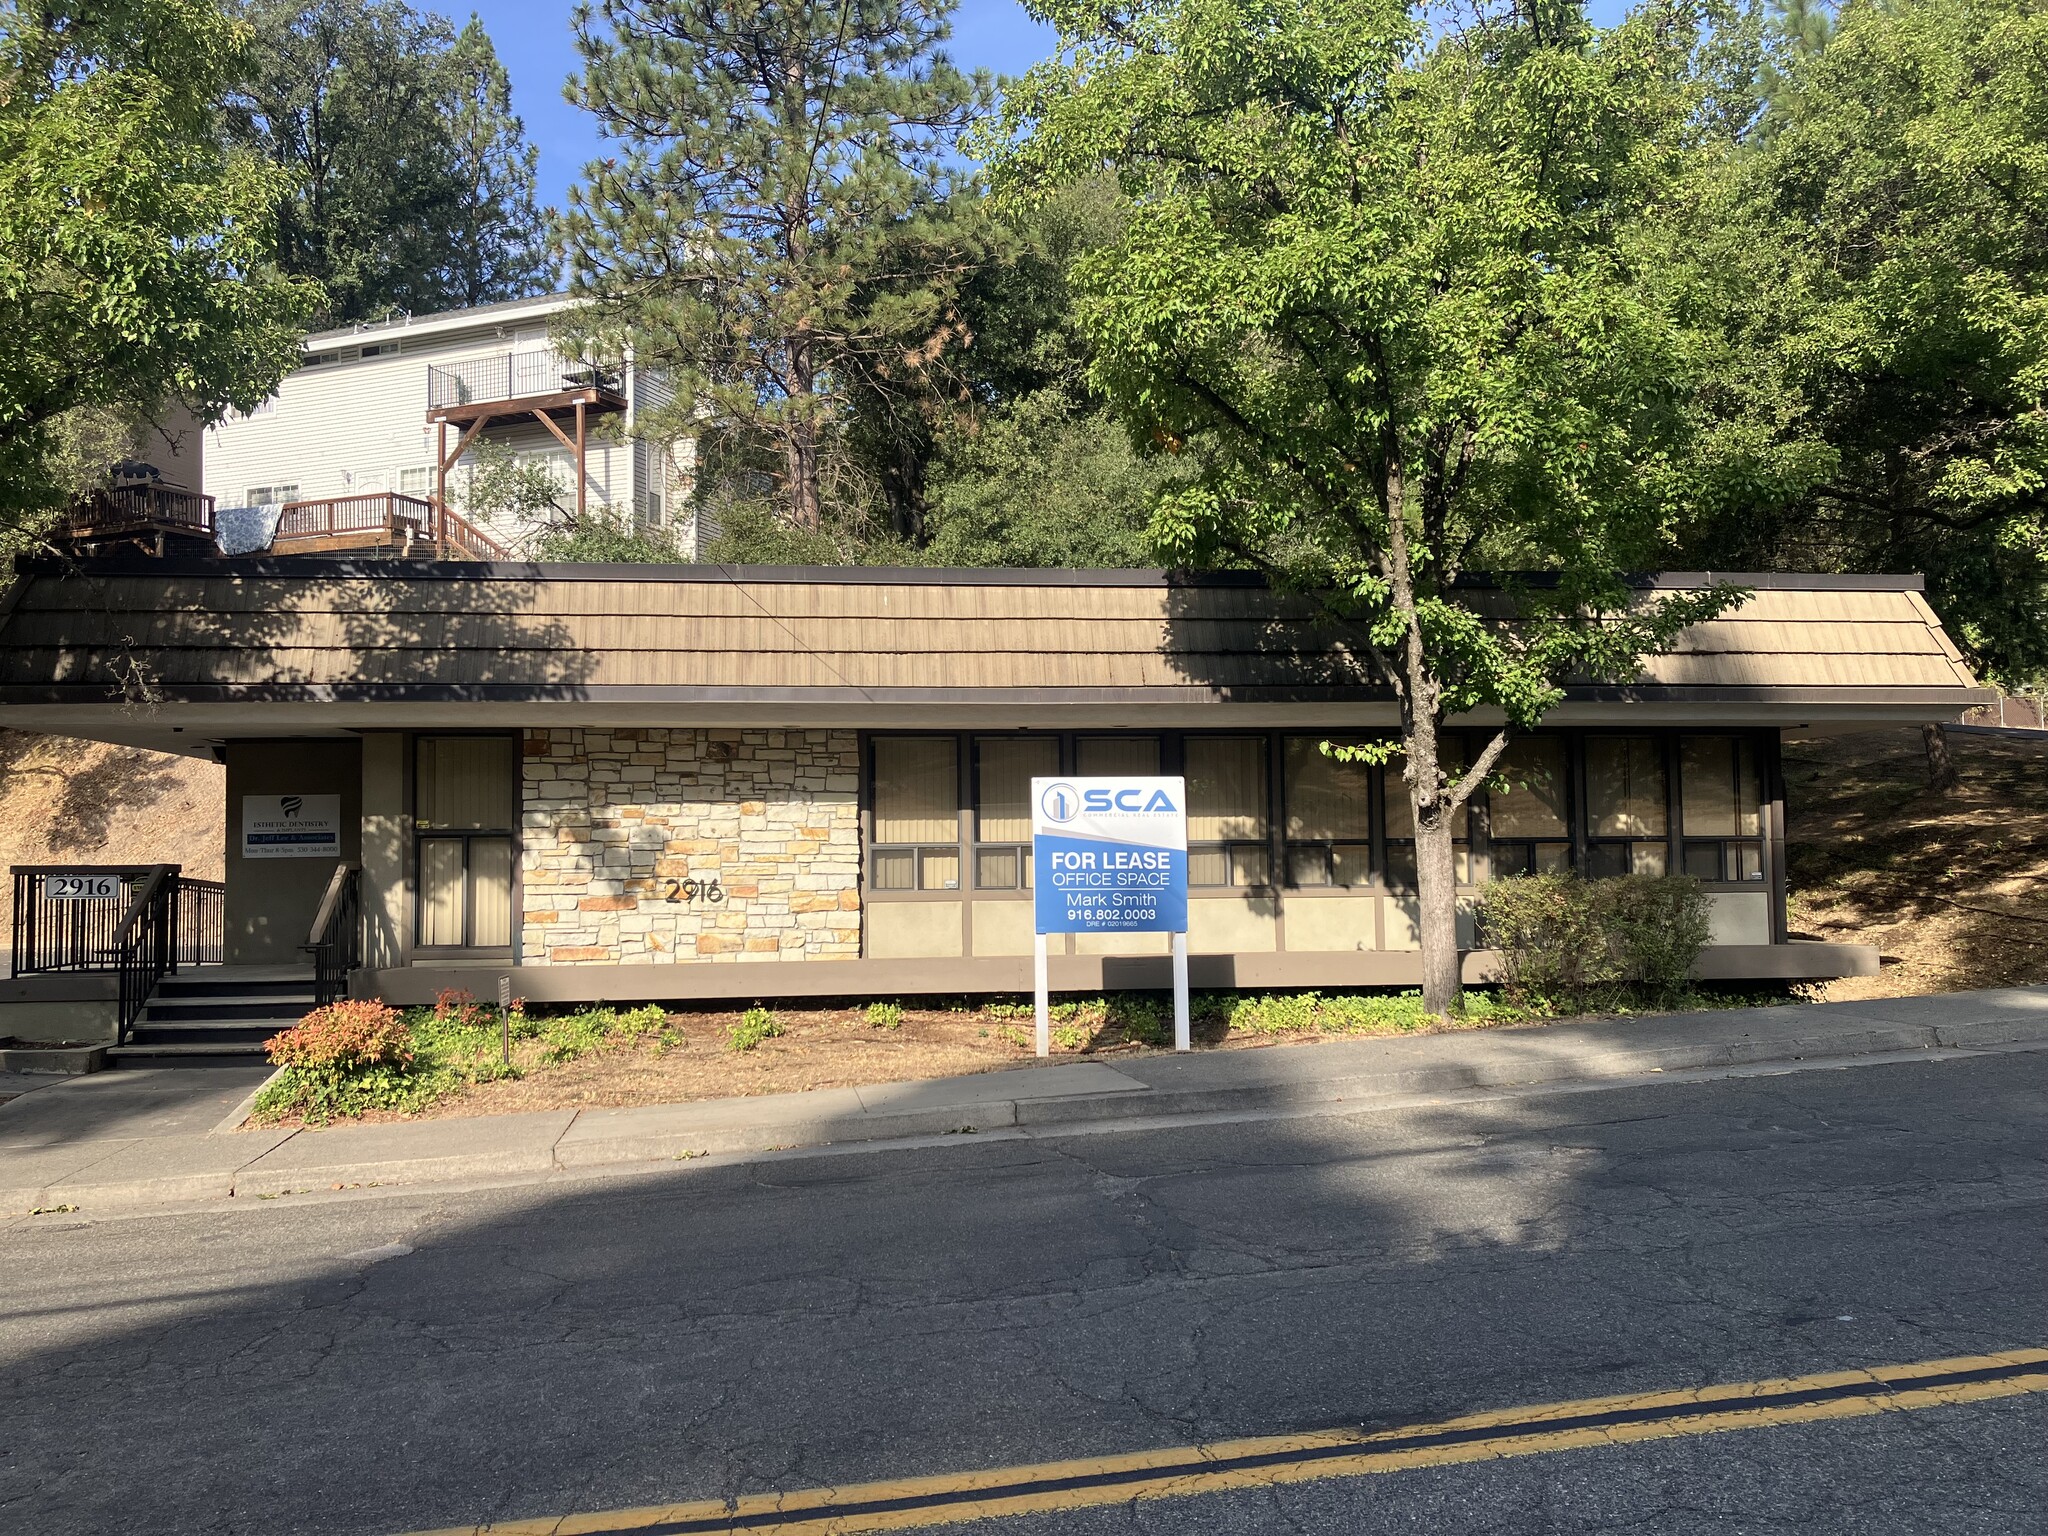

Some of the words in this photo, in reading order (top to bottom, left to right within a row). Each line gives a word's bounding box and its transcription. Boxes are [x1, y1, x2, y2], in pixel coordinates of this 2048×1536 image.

[1084, 789, 1177, 812] SCA
[262, 835, 275, 843] Jeff
[1052, 852, 1096, 870] FOR
[1103, 852, 1171, 870] LEASE
[53, 878, 111, 896] 2916
[1052, 872, 1112, 886] OFFICE
[1117, 872, 1170, 886] SPACE
[665, 878, 724, 904] 2916
[1067, 893, 1107, 906] Mark
[1112, 893, 1157, 906] Smith
[1067, 909, 1156, 920] 916.802.0003
